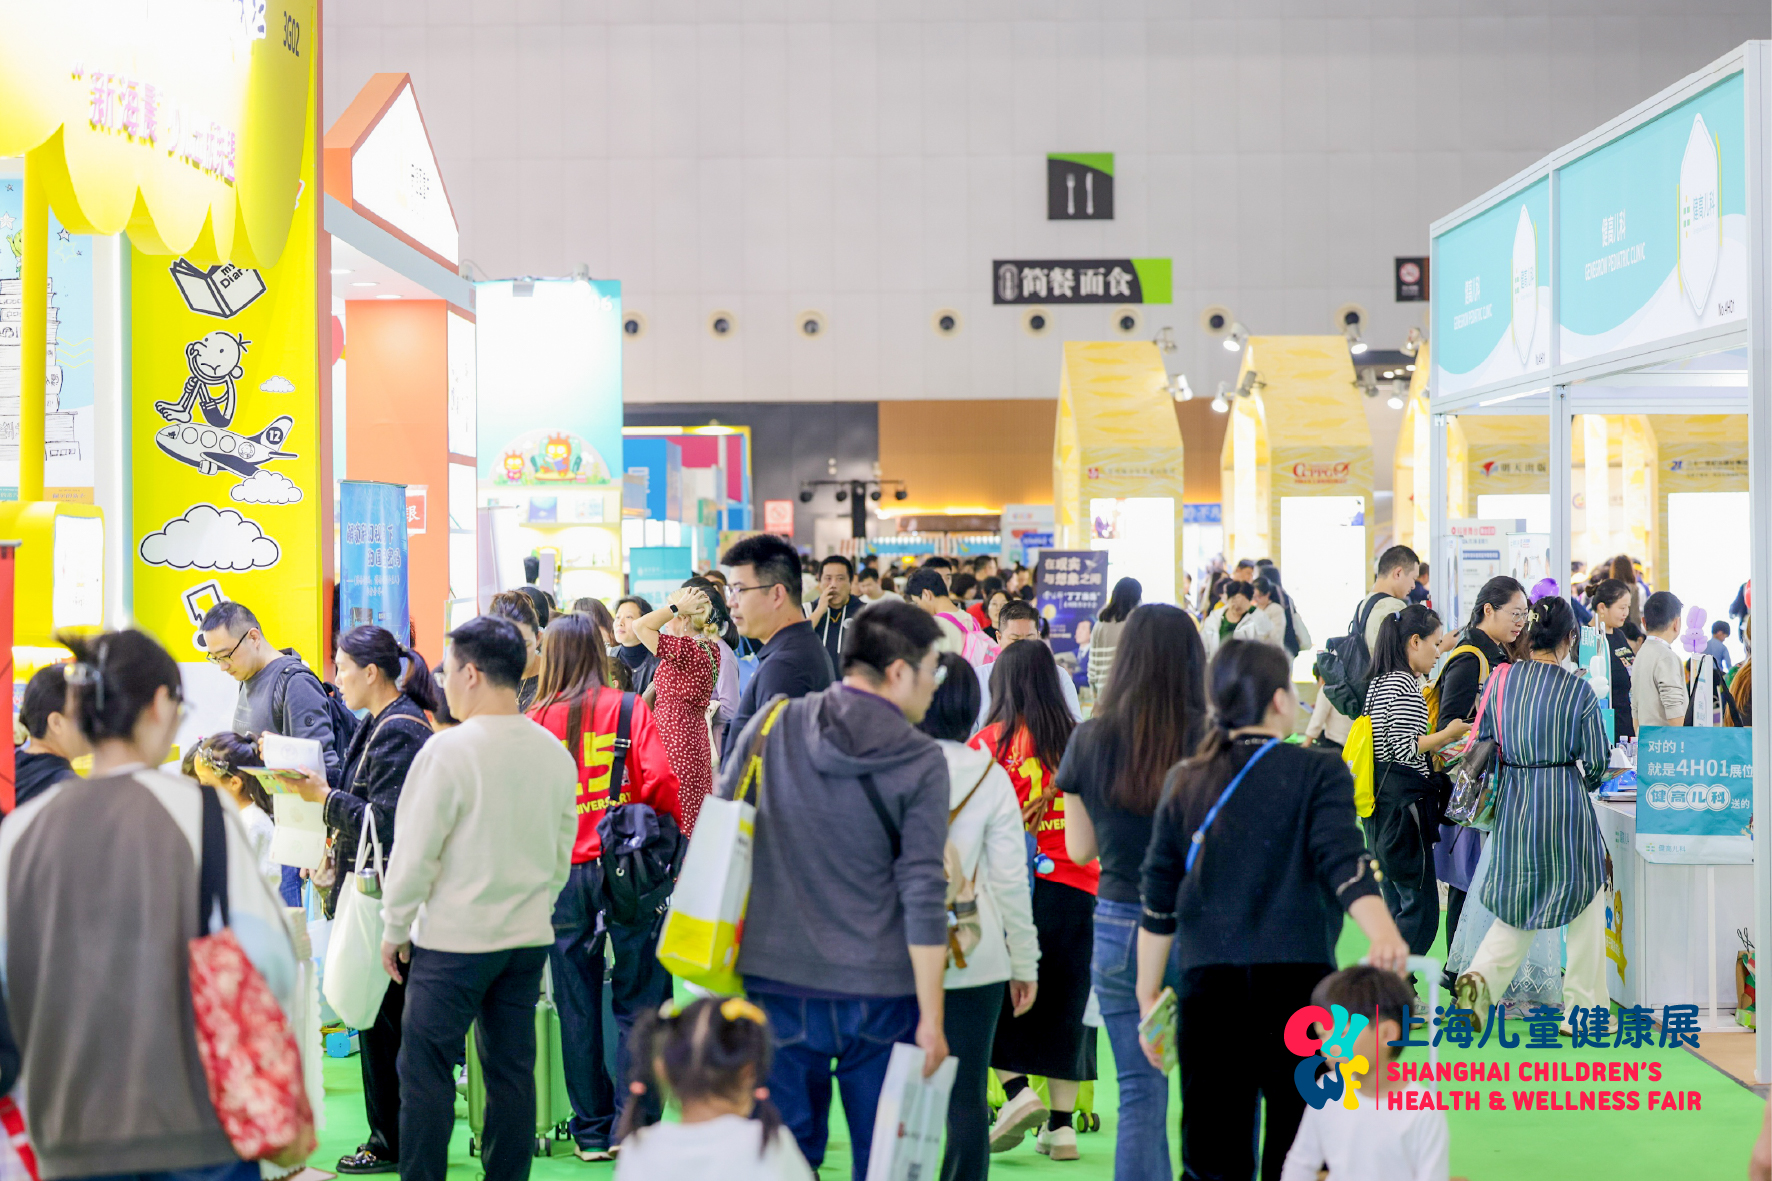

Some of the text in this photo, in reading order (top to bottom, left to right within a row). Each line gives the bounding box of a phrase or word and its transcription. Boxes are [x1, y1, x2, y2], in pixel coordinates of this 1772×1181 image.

[283, 11, 300, 57] 3G02
[1602, 208, 1626, 247] 健高儿科
[1608, 248, 1630, 272] PEDIATRIC
[1630, 242, 1646, 266] CLINIC
[220, 269, 249, 289] Diar
[221, 263, 235, 276] my
[1021, 267, 1133, 298] 简餐 面食
[268, 429, 281, 441] 12
[1648, 740, 1685, 754] 对的！
[1647, 759, 1753, 779] 就是4H01展位
[1649, 787, 1750, 810] 健高儿科 送的
